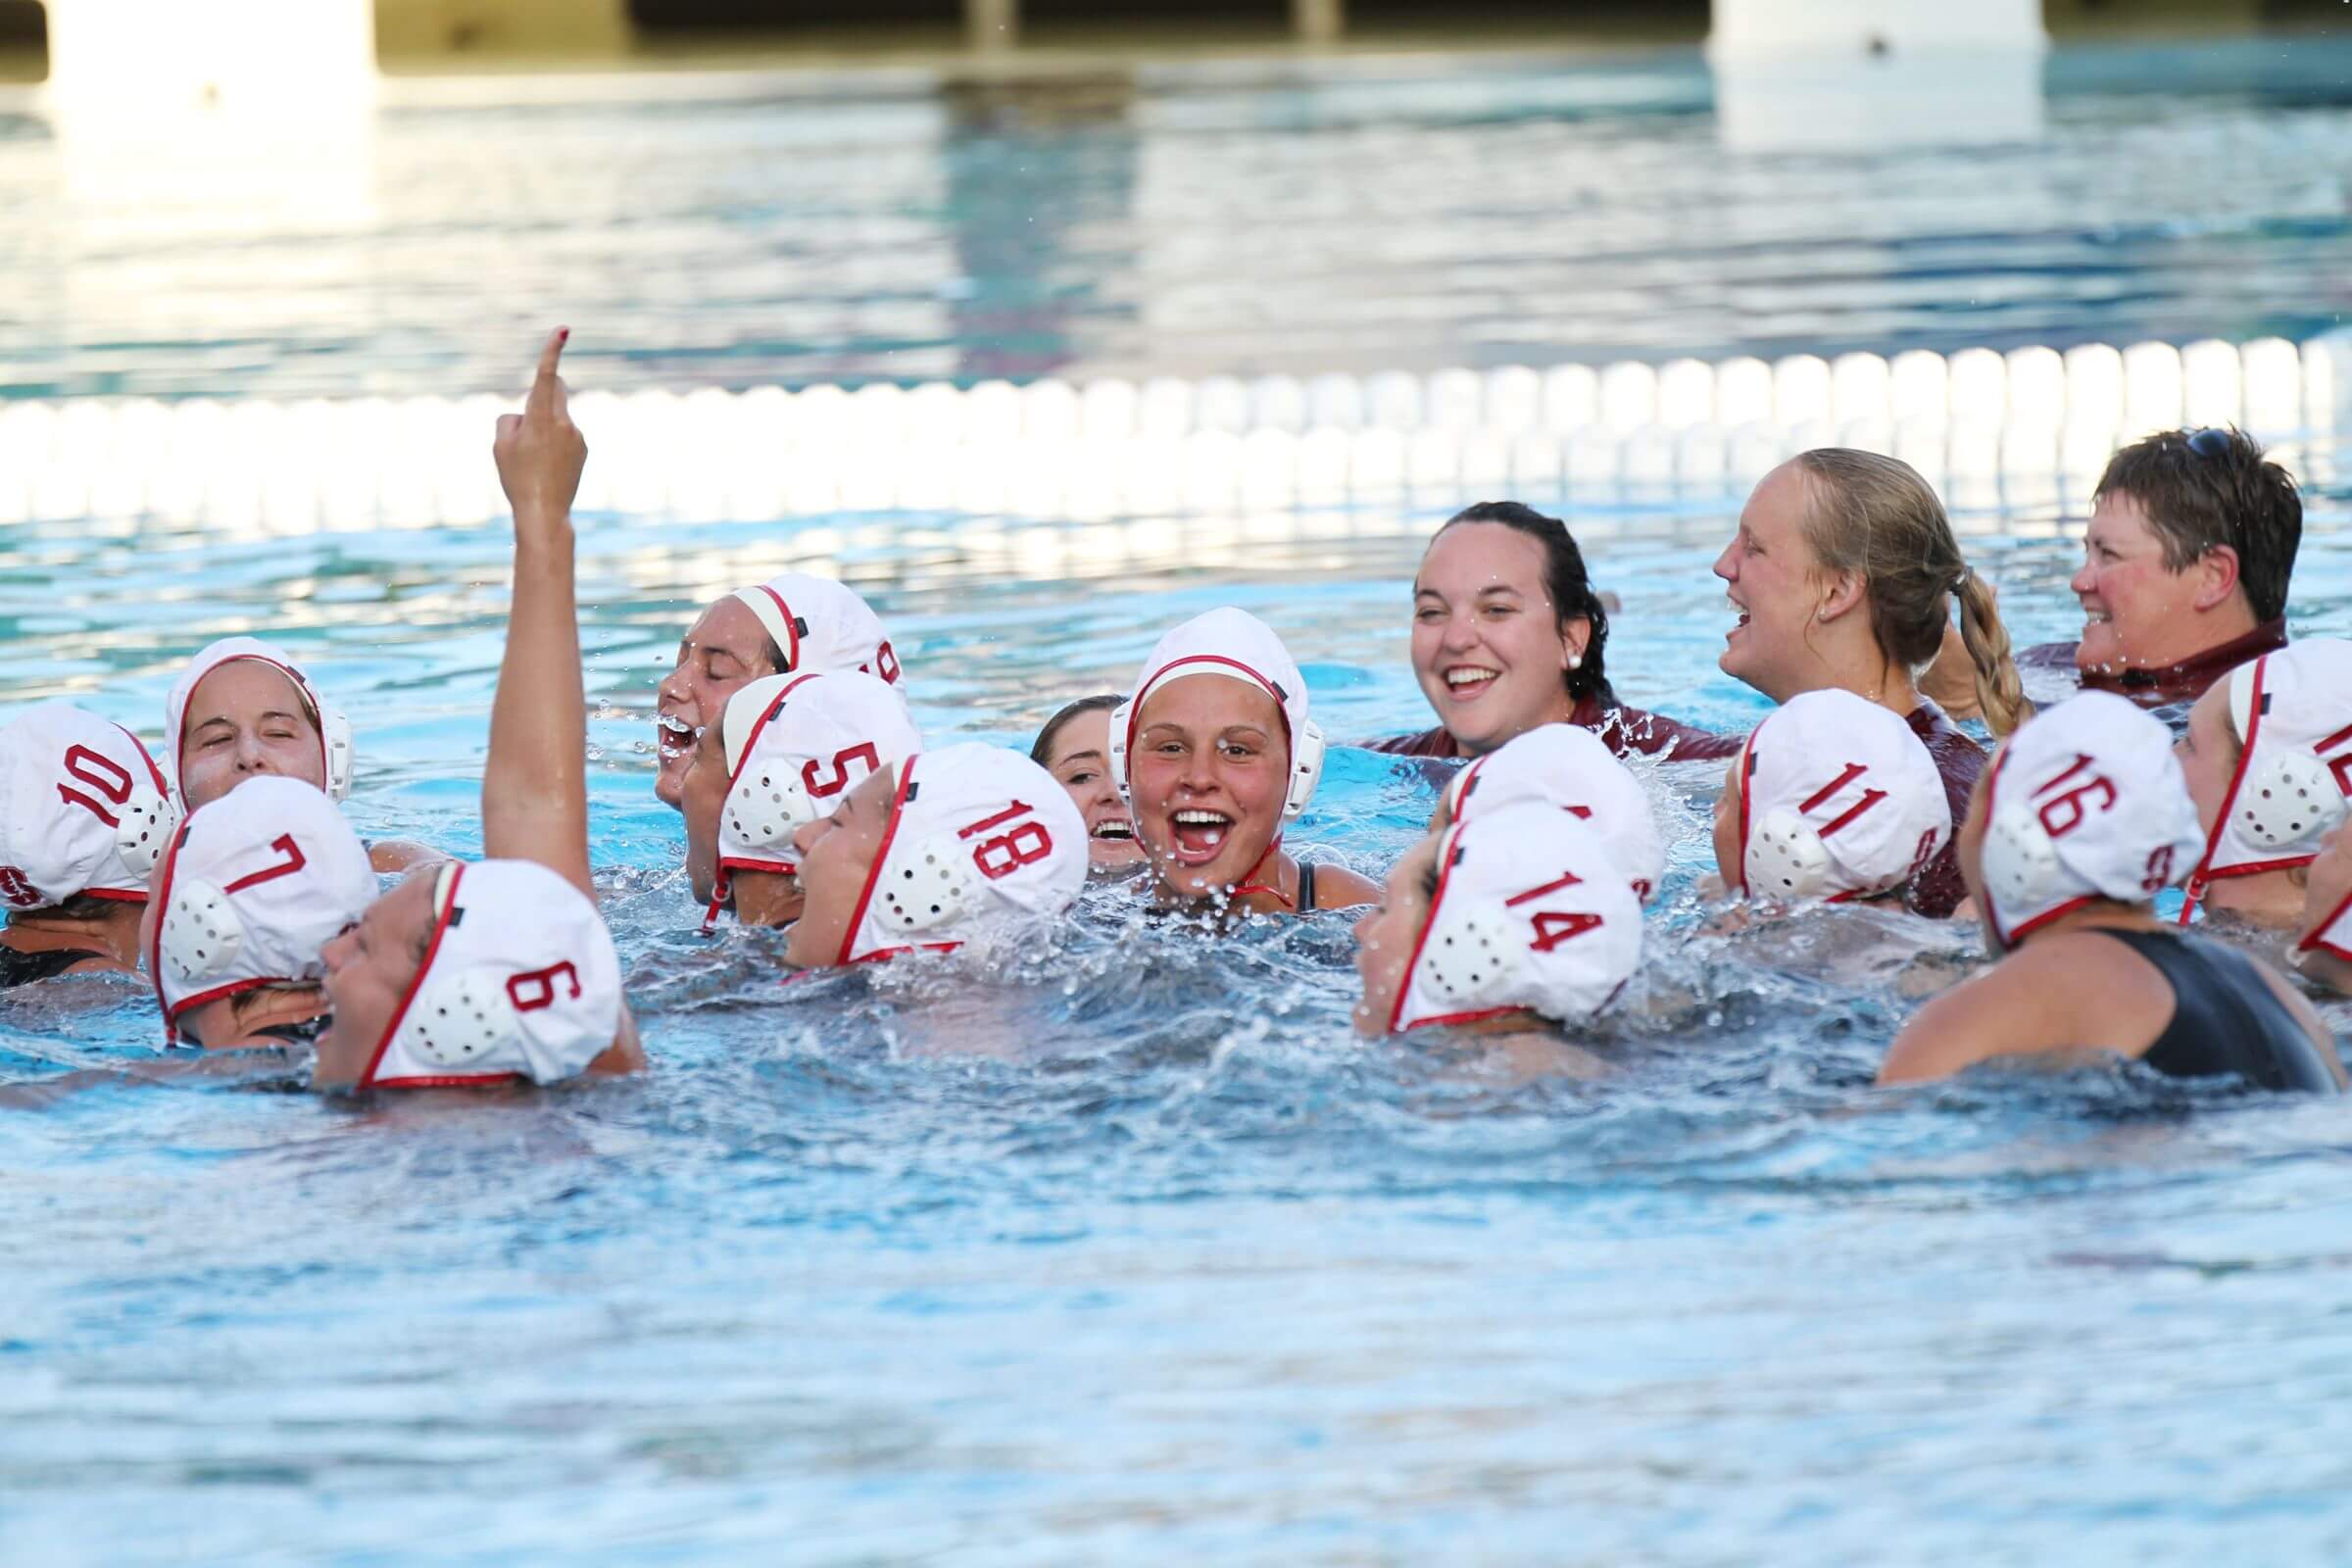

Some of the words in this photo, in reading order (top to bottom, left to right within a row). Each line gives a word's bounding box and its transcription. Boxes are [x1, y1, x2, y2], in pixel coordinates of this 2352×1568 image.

[57, 744, 133, 828] 10
[802, 741, 880, 799] 5
[1798, 762, 1888, 840] 11
[2032, 753, 2117, 838] 16
[224, 833, 307, 895] 7
[957, 799, 1054, 879] 18
[1504, 871, 1603, 953] 14
[506, 959, 581, 1012] 6
